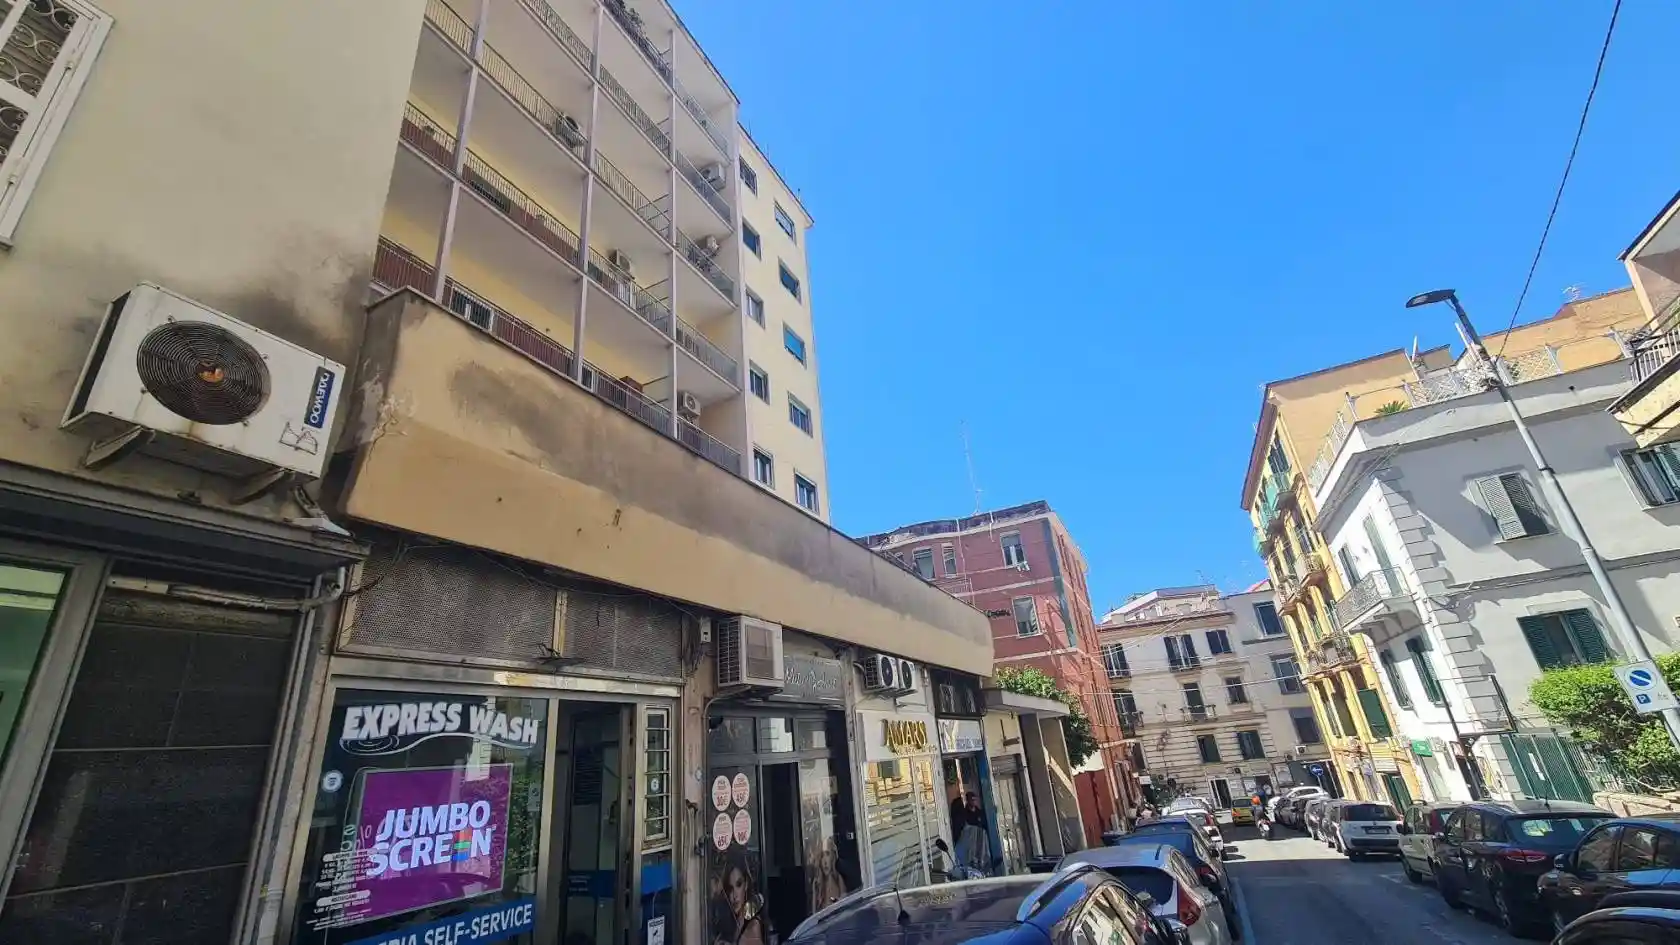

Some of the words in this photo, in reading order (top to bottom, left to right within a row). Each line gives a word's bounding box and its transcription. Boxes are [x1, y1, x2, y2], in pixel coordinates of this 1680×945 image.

[309, 372, 330, 424] DAEWOO
[341, 702, 463, 740] EXPRESS
[469, 704, 539, 744] WASH
[375, 799, 491, 842] JUMBO
[424, 903, 533, 945] SELF-SERVICE
